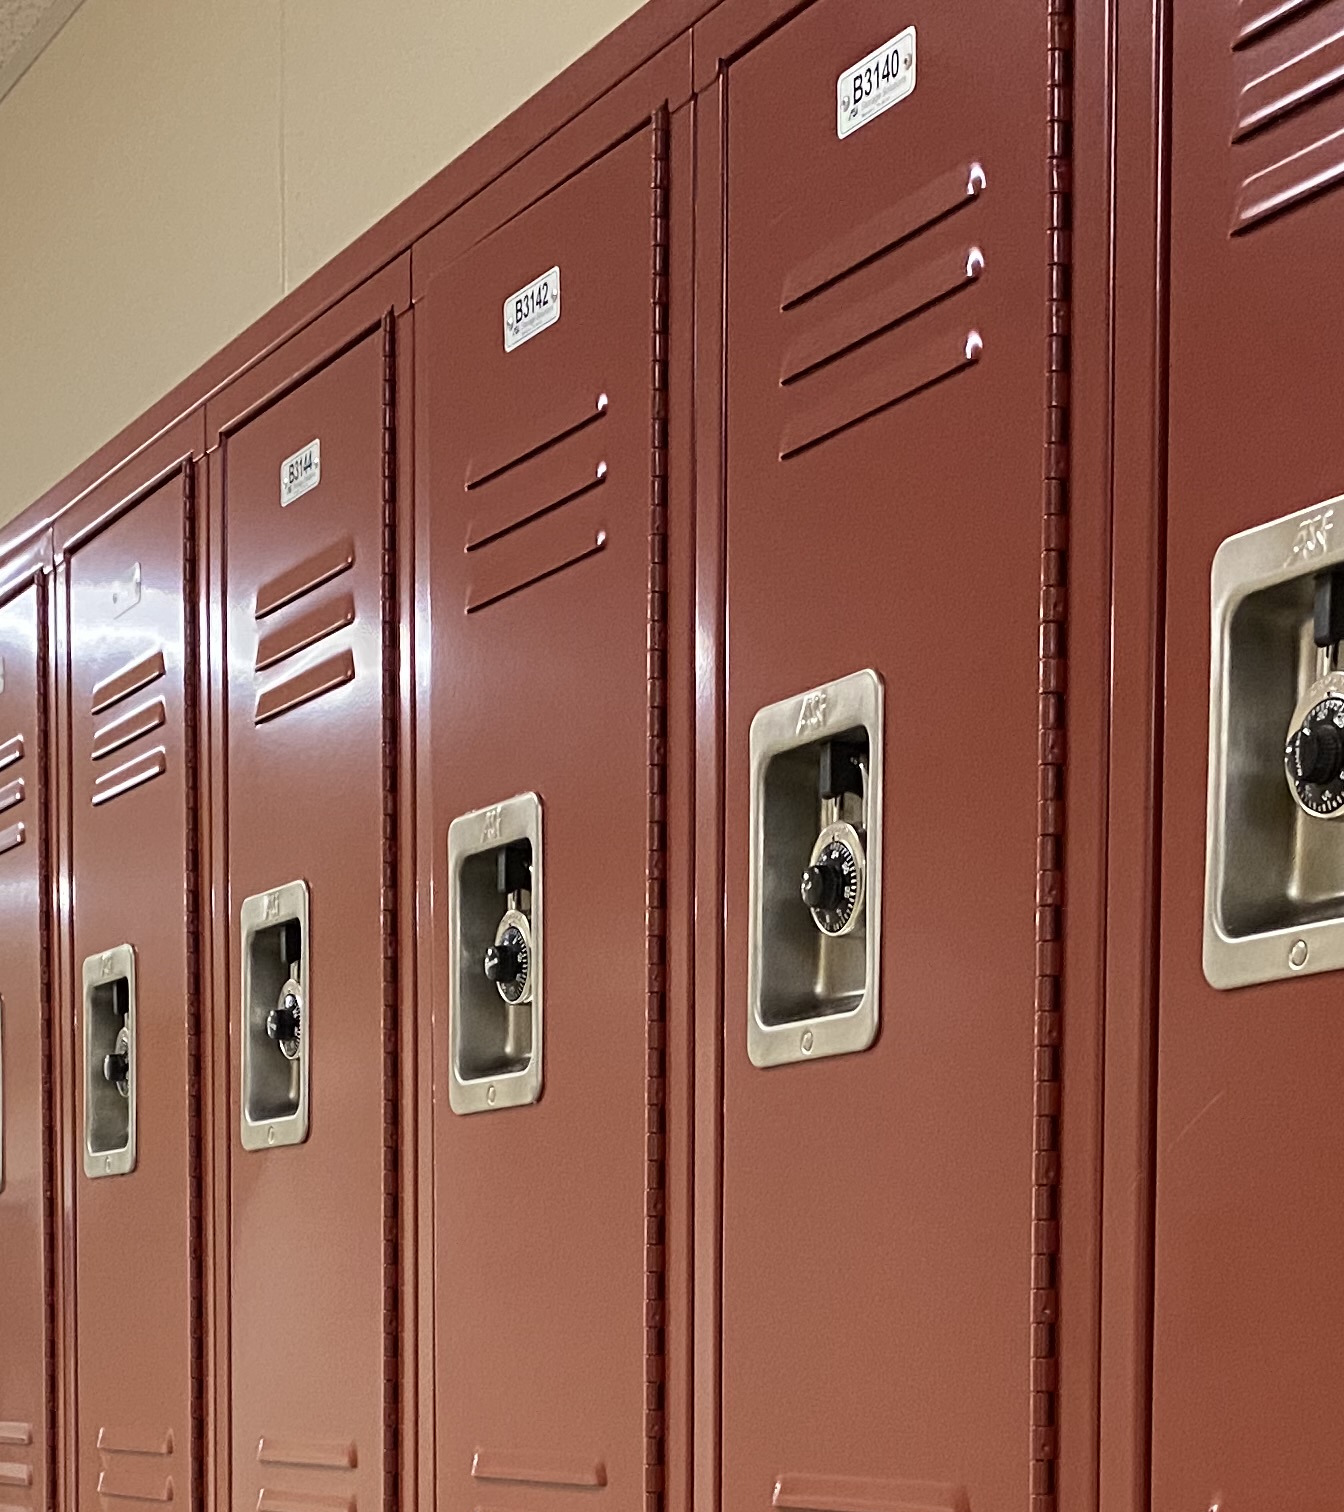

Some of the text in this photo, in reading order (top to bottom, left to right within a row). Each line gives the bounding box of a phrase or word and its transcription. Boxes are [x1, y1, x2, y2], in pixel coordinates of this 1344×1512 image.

[853, 48, 900, 106] B3140
[516, 282, 549, 324] B3142
[288, 449, 313, 484] B3144
